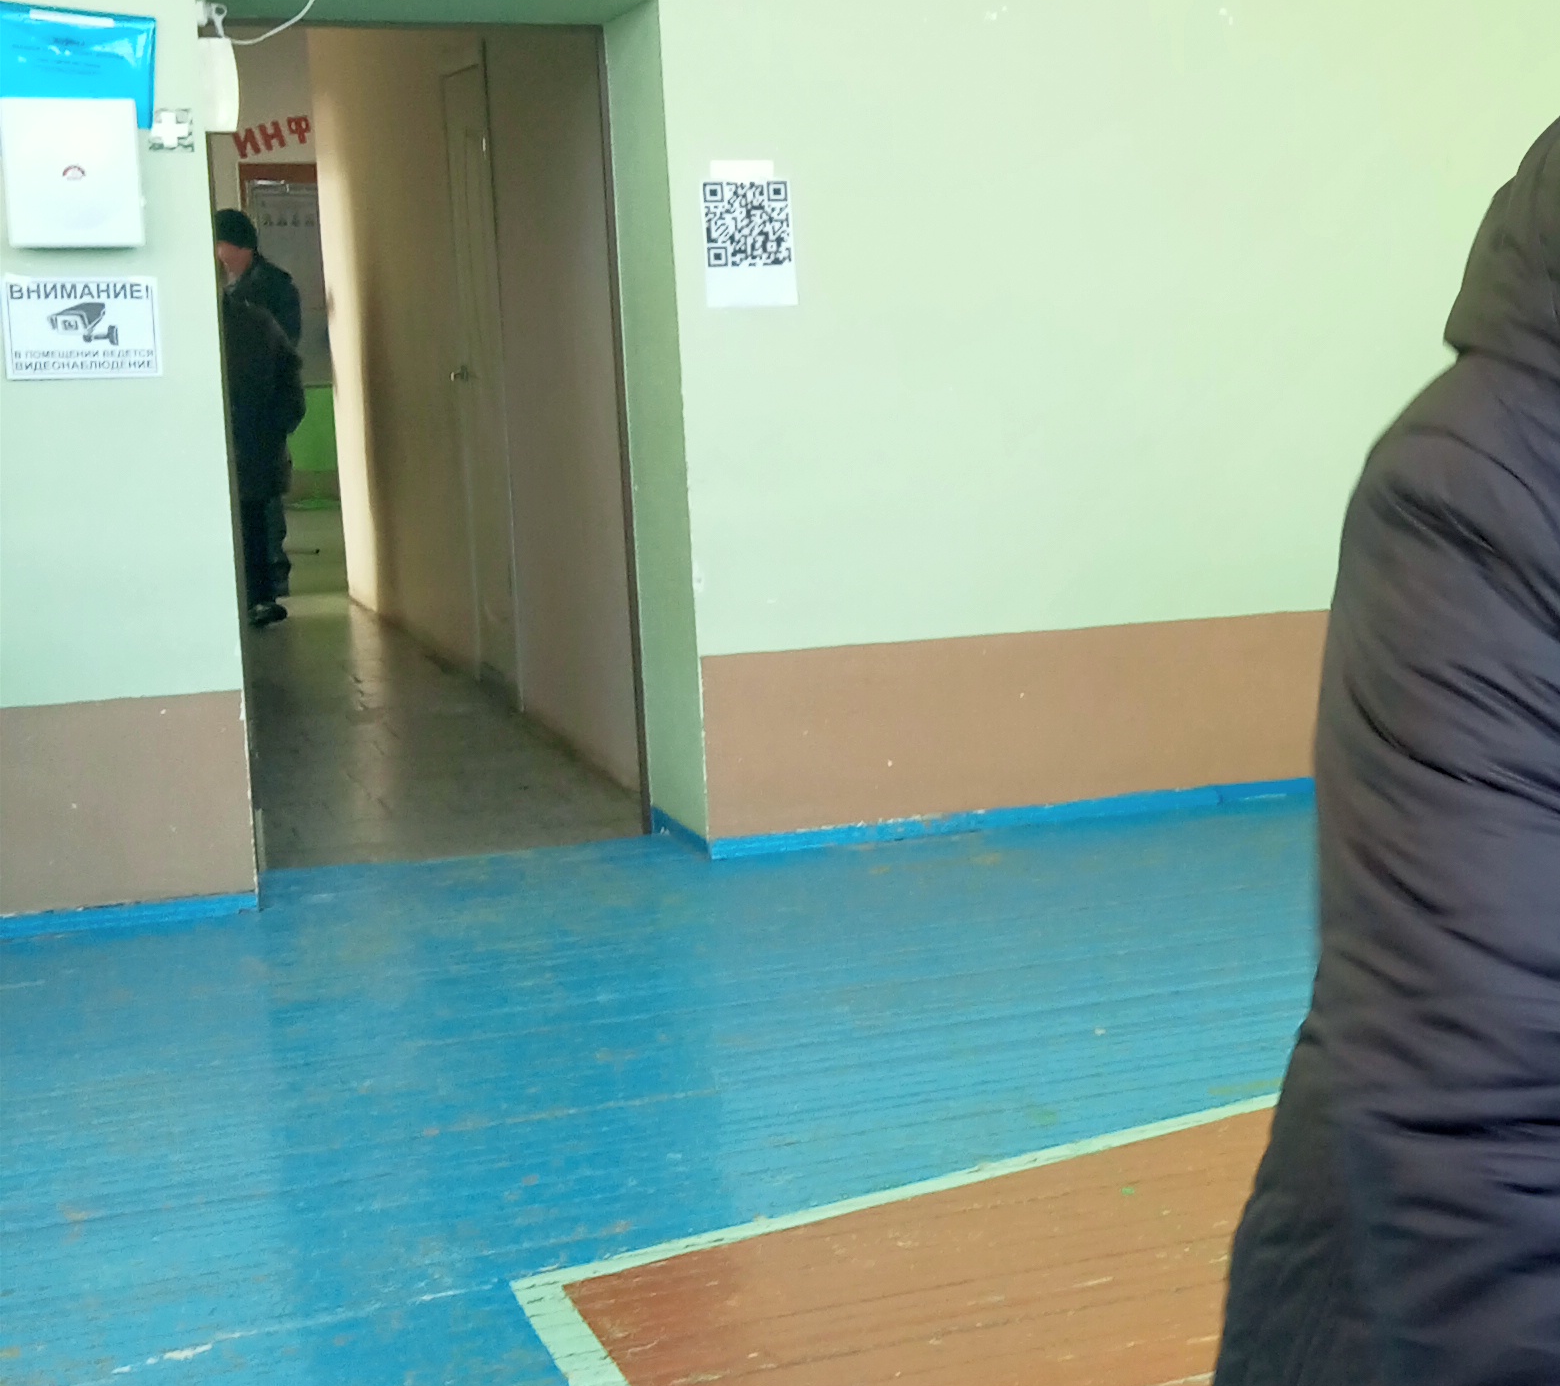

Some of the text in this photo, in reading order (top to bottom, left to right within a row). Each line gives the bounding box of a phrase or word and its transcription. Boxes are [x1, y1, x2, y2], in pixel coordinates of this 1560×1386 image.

[9, 282, 150, 300] ВНИМАНИЕ!
[14, 350, 21, 359] В
[25, 349, 100, 360] ПОМЕЩЕНИИ
[15, 360, 153, 372] ВИДЕОНАБЛЮДЕНИЕ
